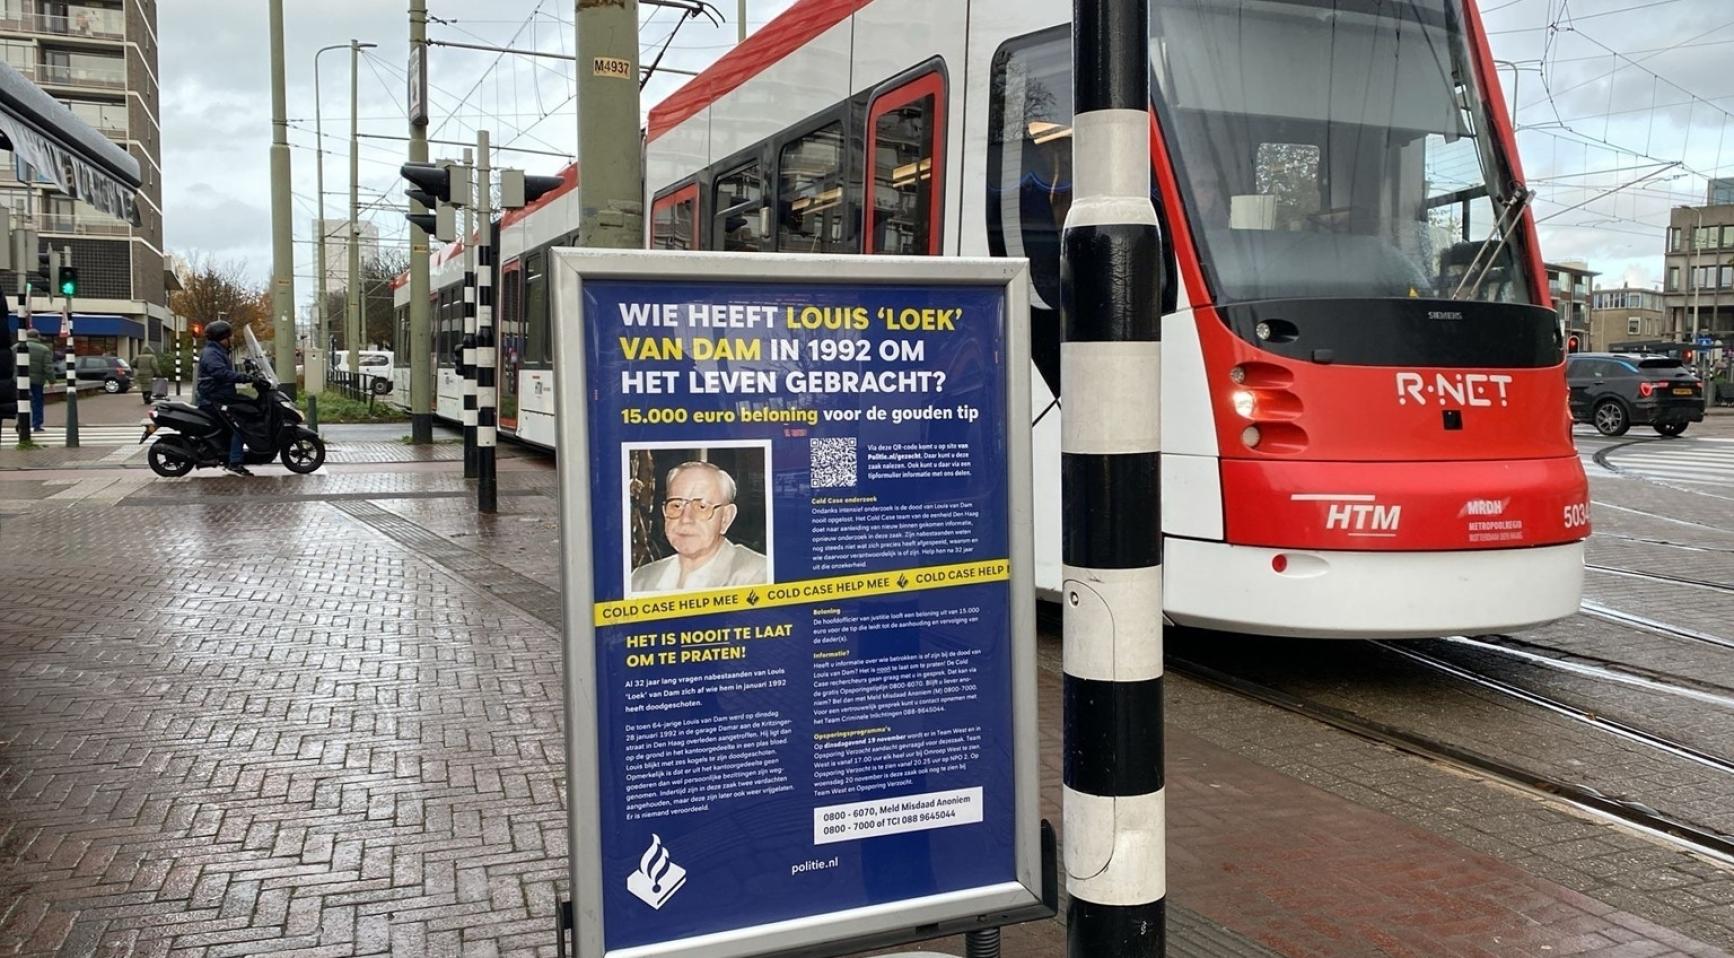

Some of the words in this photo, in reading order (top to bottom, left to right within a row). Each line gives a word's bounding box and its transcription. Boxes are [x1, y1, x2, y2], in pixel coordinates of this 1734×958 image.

[595, 60, 629, 75] M4937
[619, 304, 678, 326] WIE
[689, 304, 778, 328] HEEFT
[786, 307, 868, 330] LOUIS
[619, 337, 682, 360] VAN
[693, 338, 760, 360] DAM
[770, 340, 798, 360] IN
[807, 339, 870, 361] 1992
[878, 340, 924, 361] OM
[622, 371, 679, 393] HET
[689, 371, 776, 393] LEVEN
[785, 370, 945, 393] GEBRACHT?
[620, 408, 687, 424] 15.000
[693, 411, 735, 422] euro
[740, 407, 817, 425] beloning
[823, 409, 861, 420] voor
[866, 406, 886, 420] de
[892, 406, 952, 422] gouden
[956, 404, 978, 422] tip
[1326, 504, 1401, 530] HTM
[1467, 500, 1502, 515] MRDH
[916, 572, 945, 583] COLD
[948, 568, 975, 580] CASE
[978, 565, 1004, 576] HELP
[768, 588, 800, 600] COLD
[804, 584, 832, 596] CASE
[836, 581, 864, 593] HELP
[867, 578, 889, 589] MEE
[603, 605, 638, 618] COLD
[642, 601, 674, 614] CASE
[679, 598, 709, 610] HELP
[713, 595, 738, 607] MEE
[627, 635, 657, 648] HET
[662, 634, 676, 646] IS
[681, 630, 730, 644] NOOIT
[734, 628, 751, 640] TE
[755, 625, 792, 639] LAAT
[627, 654, 654, 668] OM
[658, 652, 676, 665] TE
[681, 647, 746, 663] PRATEN!
[824, 811, 846, 821] 0800
[853, 808, 877, 817] 6070,
[880, 804, 899, 814] Meld
[902, 800, 935, 811] Misdaad
[937, 796, 970, 807] Anoniem
[824, 824, 845, 834] 0800
[854, 820, 875, 830] 7000
[877, 819, 884, 828] of
[888, 817, 900, 826] TCI
[902, 815, 918, 824] 088
[920, 810, 955, 822] 9645044
[792, 858, 839, 875] politie.nl
